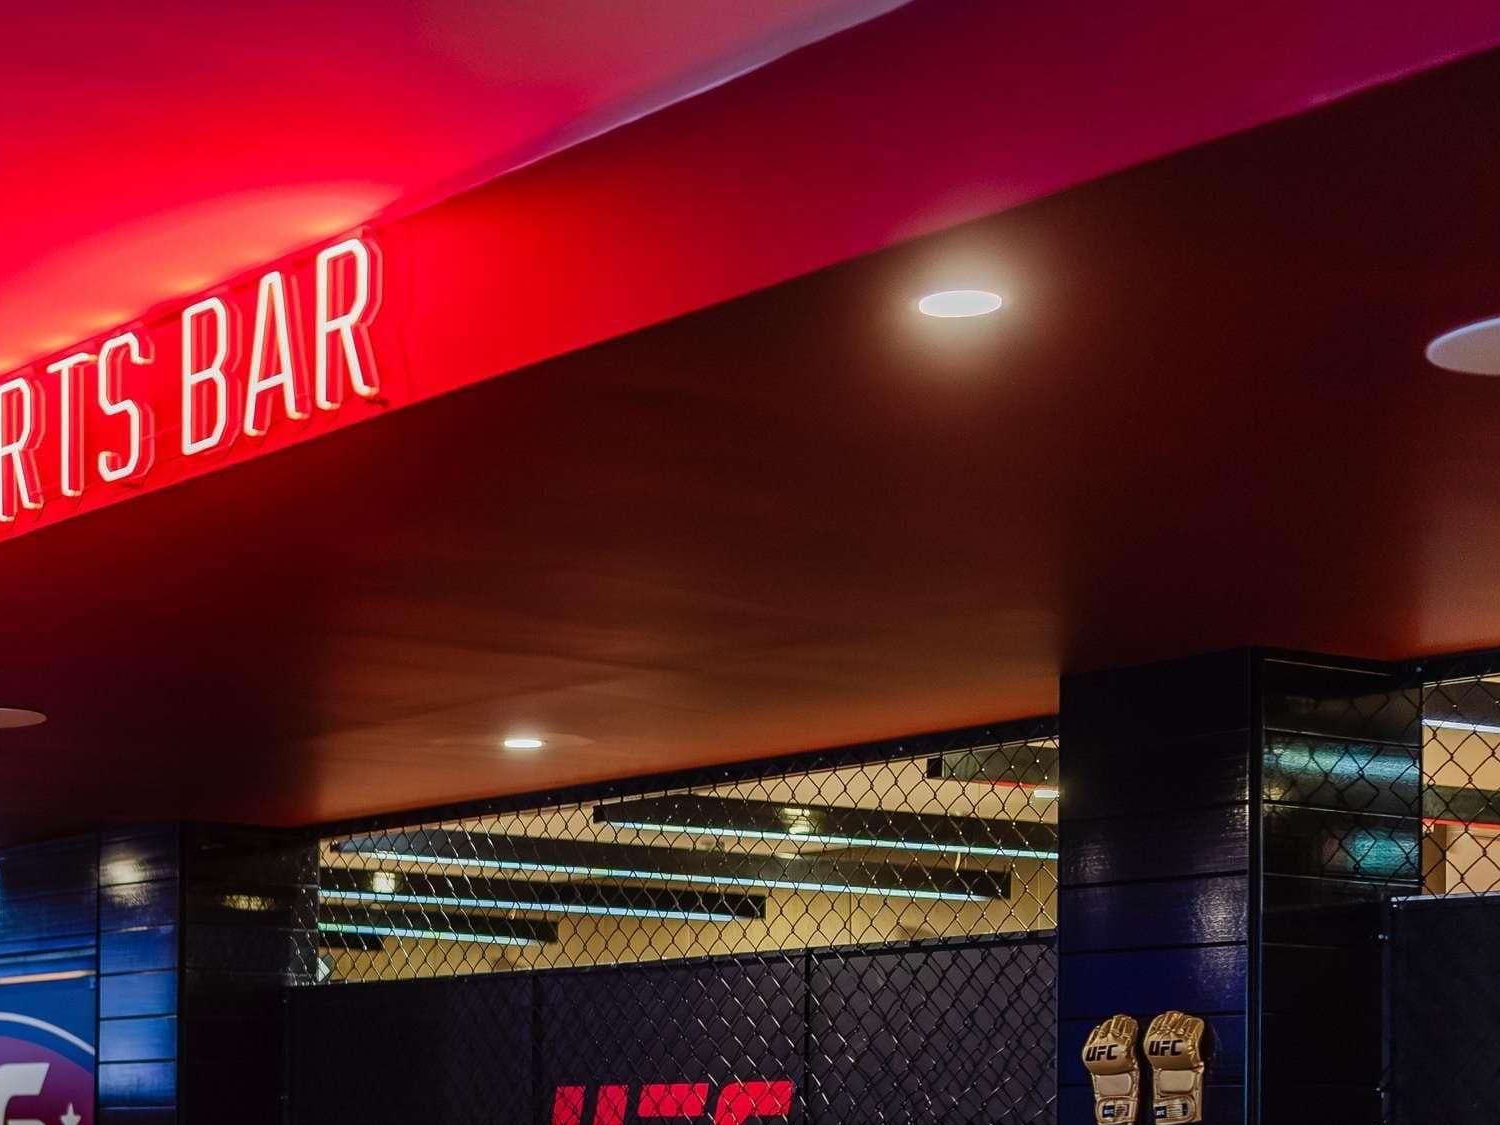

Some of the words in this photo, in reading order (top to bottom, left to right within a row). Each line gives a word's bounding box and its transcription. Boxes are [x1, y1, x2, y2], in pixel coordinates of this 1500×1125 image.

[182, 238, 380, 456] BAR
[1085, 1044, 1119, 1062] UFC
[1148, 1039, 1183, 1057] UFC
